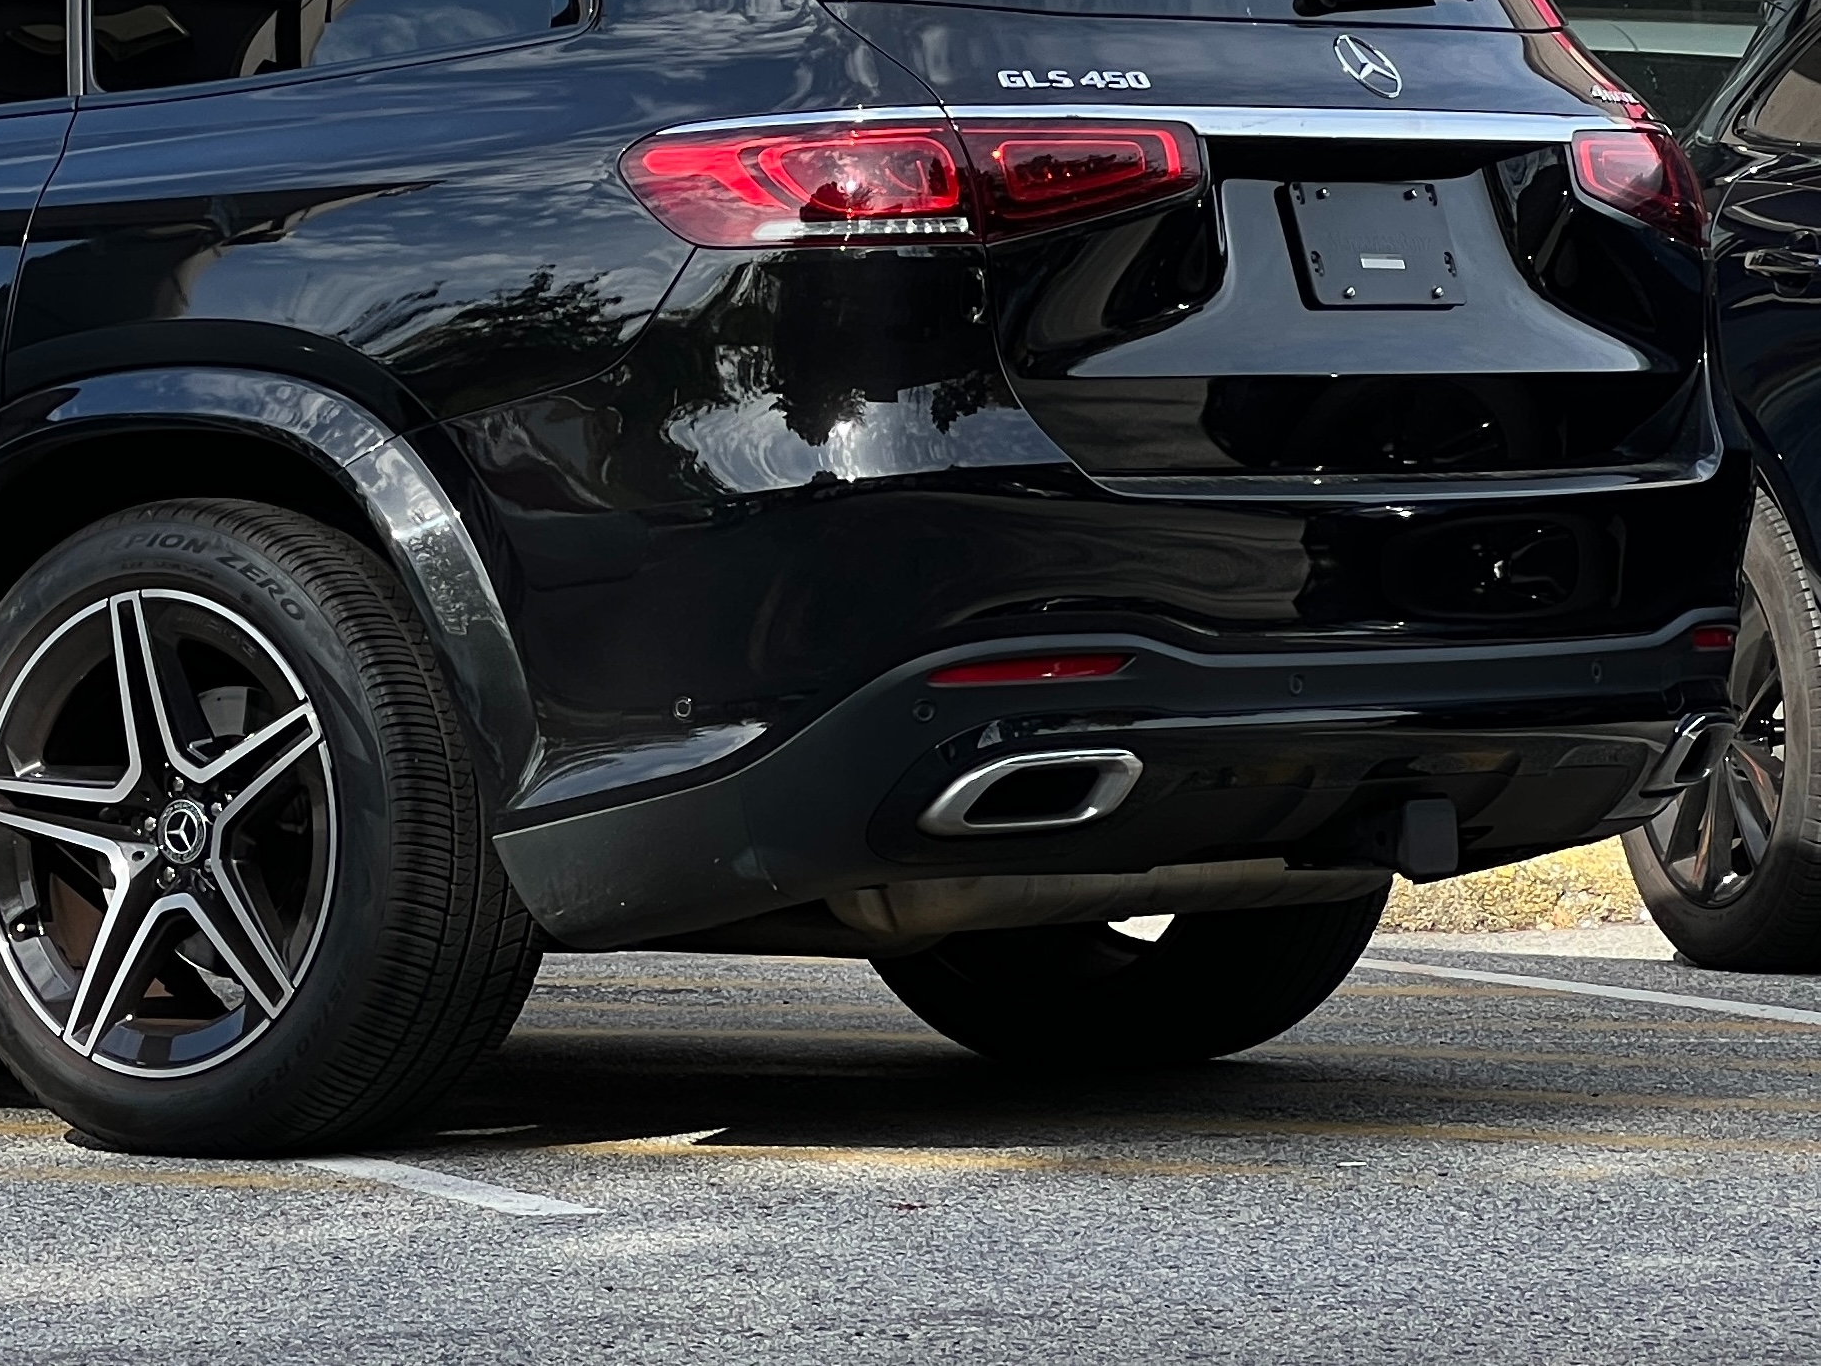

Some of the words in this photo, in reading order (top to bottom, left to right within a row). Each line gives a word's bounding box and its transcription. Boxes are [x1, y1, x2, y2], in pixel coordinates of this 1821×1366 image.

[998, 71, 1074, 87] GLS
[1080, 71, 1150, 88] 450
[215, 552, 306, 622] ZERO
